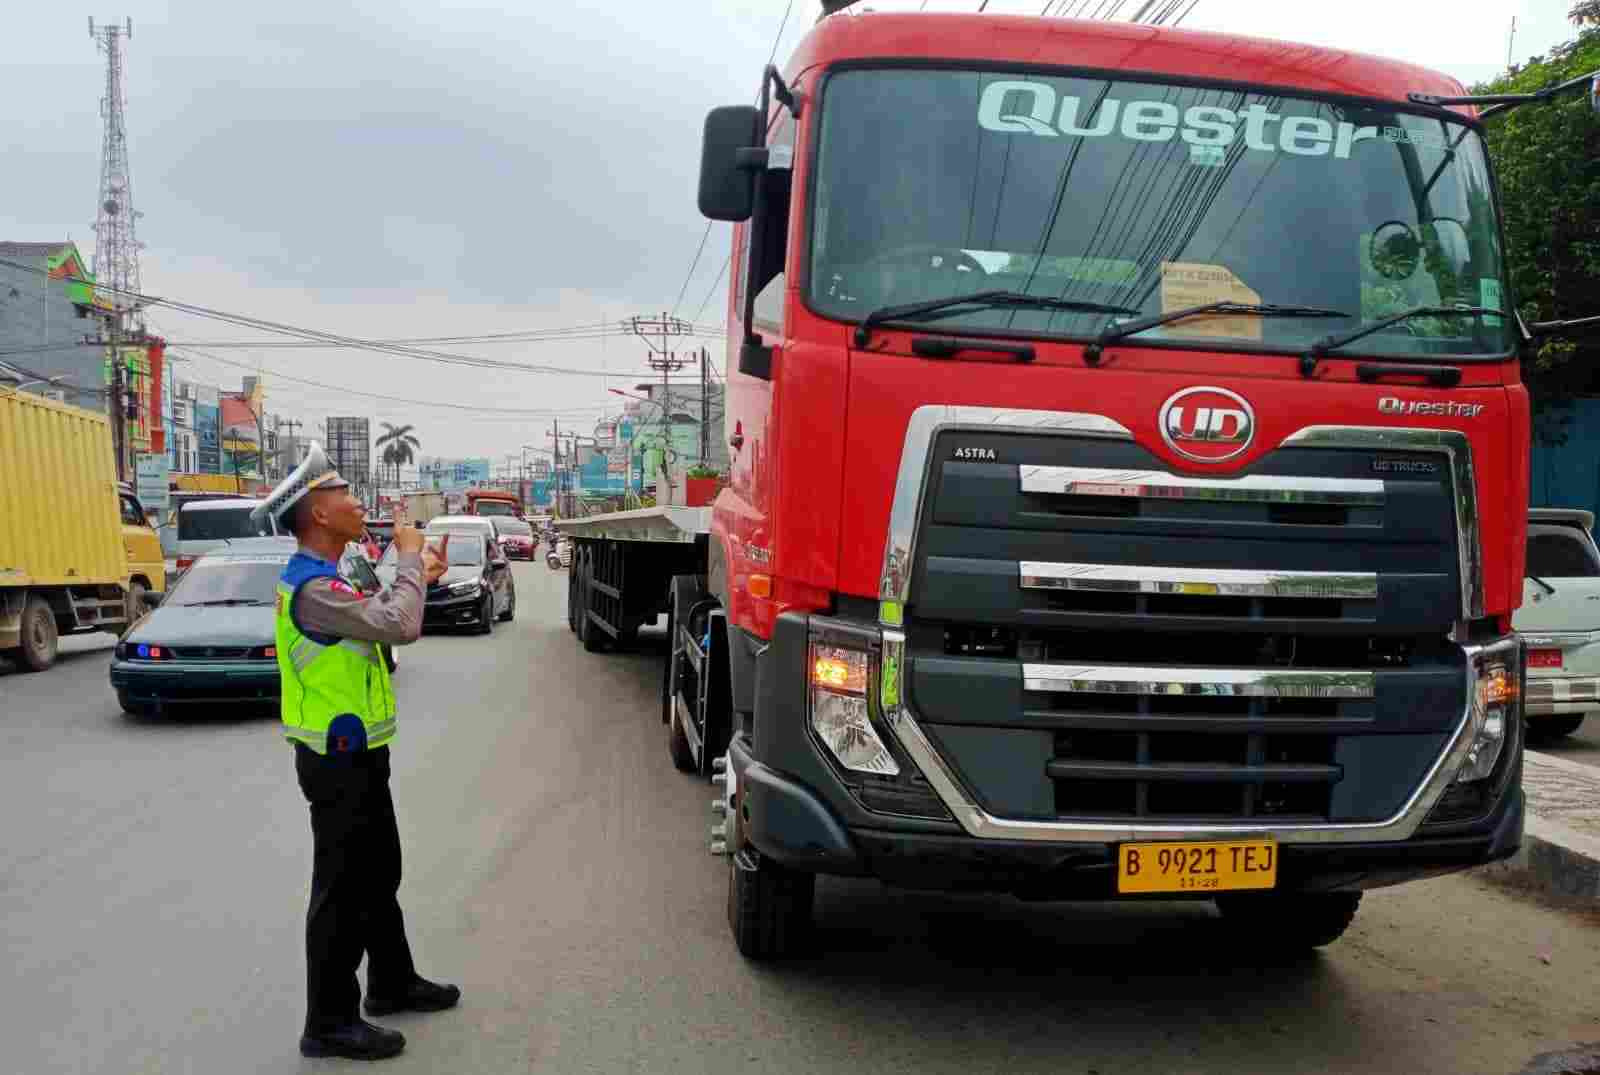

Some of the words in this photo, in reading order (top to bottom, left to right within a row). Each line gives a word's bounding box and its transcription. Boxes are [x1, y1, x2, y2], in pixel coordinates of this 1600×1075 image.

[977, 80, 1377, 159] Quester
[1377, 396, 1485, 417] Quester
[1167, 406, 1251, 441] UD
[954, 447, 996, 460] ASTRA
[1126, 849, 1141, 876] B
[1158, 848, 1217, 875] 9921
[1229, 846, 1273, 873] TEJ
